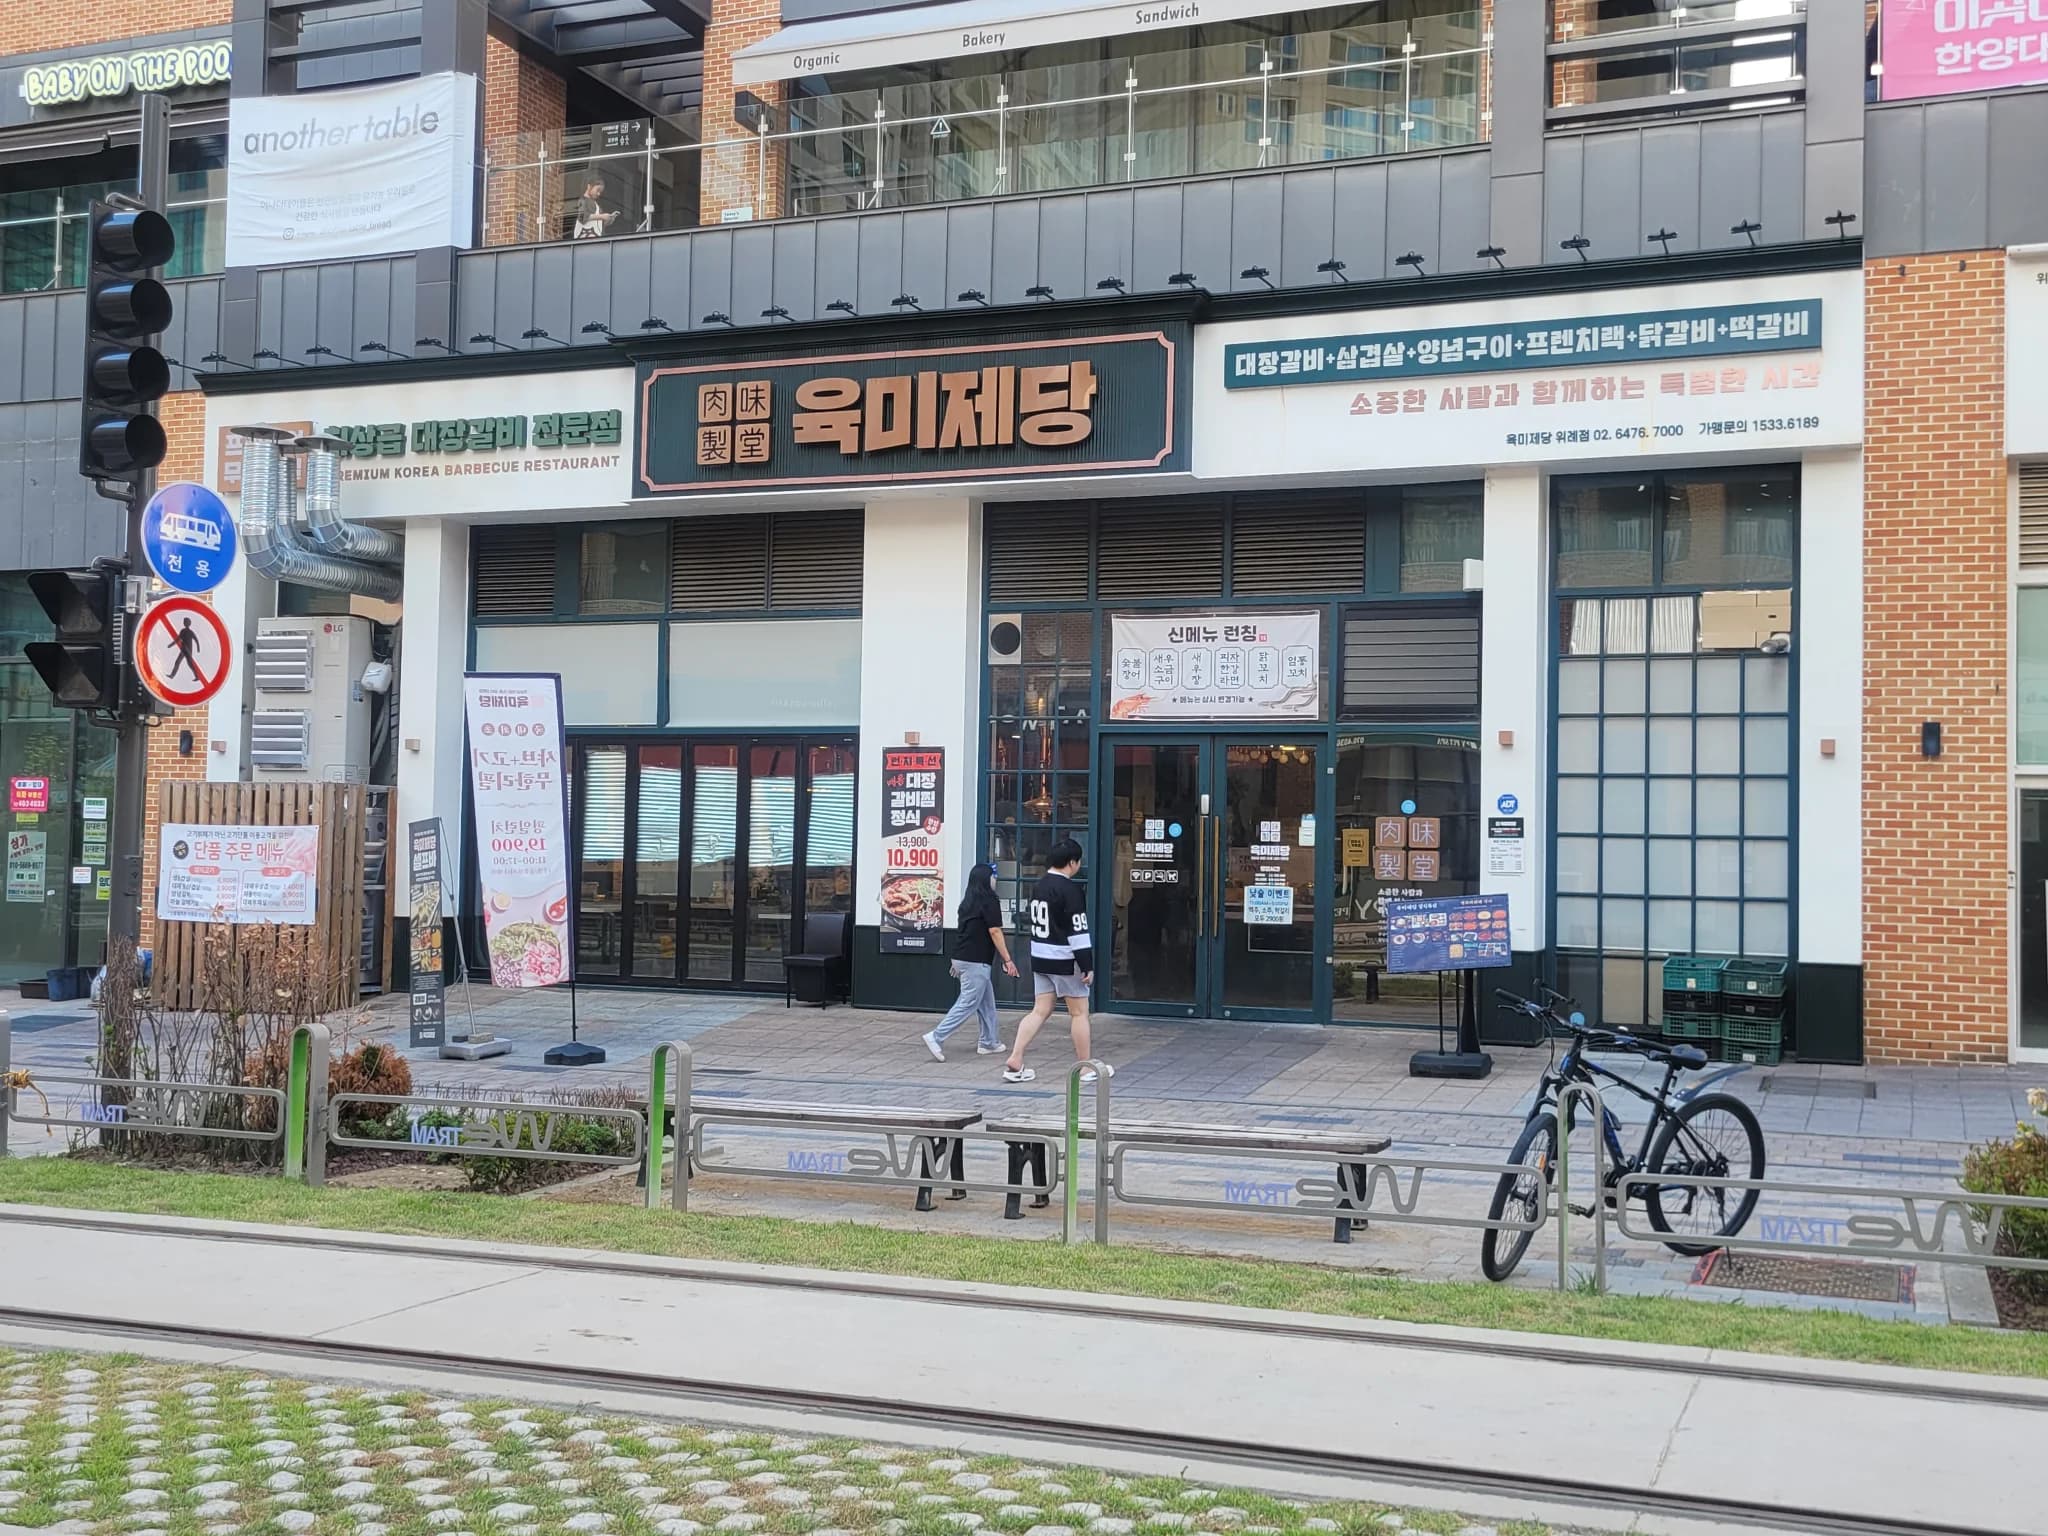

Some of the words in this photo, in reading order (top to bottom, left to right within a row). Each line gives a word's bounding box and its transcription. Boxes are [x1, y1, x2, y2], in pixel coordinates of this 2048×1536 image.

[1135, 3, 1200, 24] Sandwich
[962, 31, 1006, 48] Bakery
[793, 52, 840, 70] Organic
[26, 67, 87, 104] BABY
[89, 57, 125, 94] ON
[131, 51, 181, 90] THE
[183, 43, 232, 85] POO
[244, 118, 360, 155] another
[364, 103, 440, 146] table
[1350, 389, 1427, 415] 소중한
[1440, 383, 1519, 410] 사람과
[1532, 376, 1645, 405] 함께하는
[1660, 367, 1747, 396] 특별한
[1761, 361, 1821, 391] 시간
[702, 382, 768, 417] 肉味
[793, 360, 1097, 454] 육미제당
[411, 415, 527, 455] 대장갈비
[532, 409, 623, 447] 전문점
[1506, 432, 1552, 447] 육미제당
[1555, 429, 1590, 443] 위례점
[1652, 424, 1684, 438] 7000
[1699, 421, 1748, 436] 가맹문의
[1752, 416, 1819, 433] 1533.6189
[701, 426, 766, 462] 製堂
[340, 468, 390, 482] REMIUM
[394, 464, 439, 479] KOREA
[444, 459, 520, 476] BARBECUE
[524, 455, 620, 472] RESTAURANT
[333, 625, 344, 633] LG
[1168, 626, 1218, 644] 신메뉴
[1224, 625, 1257, 643] 런칭
[1154, 653, 1175, 664] 새우
[1219, 652, 1240, 664] 피자
[1122, 669, 1141, 681] 장어
[1154, 664, 1175, 674] 소금
[1220, 664, 1239, 674] 한강
[1287, 667, 1308, 678] 꼬치
[1154, 675, 1174, 686] 구이
[1219, 675, 1240, 686] 라면
[1179, 696, 1200, 704] 메뉴는
[905, 772, 937, 789] 대장
[890, 791, 936, 808] 갈비찜
[1500, 800, 1516, 809] ADT
[890, 809, 921, 827] 정식
[1380, 820, 1436, 845] 肉味
[898, 836, 928, 848] 13,900
[1251, 845, 1291, 857] 육미제당
[194, 841, 221, 861] 단품
[225, 842, 253, 861] 주문
[256, 841, 285, 862] 메뉴
[887, 848, 938, 868] 10,900
[1379, 853, 1436, 879] 製堂
[1267, 889, 1289, 899] 이벤트
[1072, 912, 1088, 931] 99
